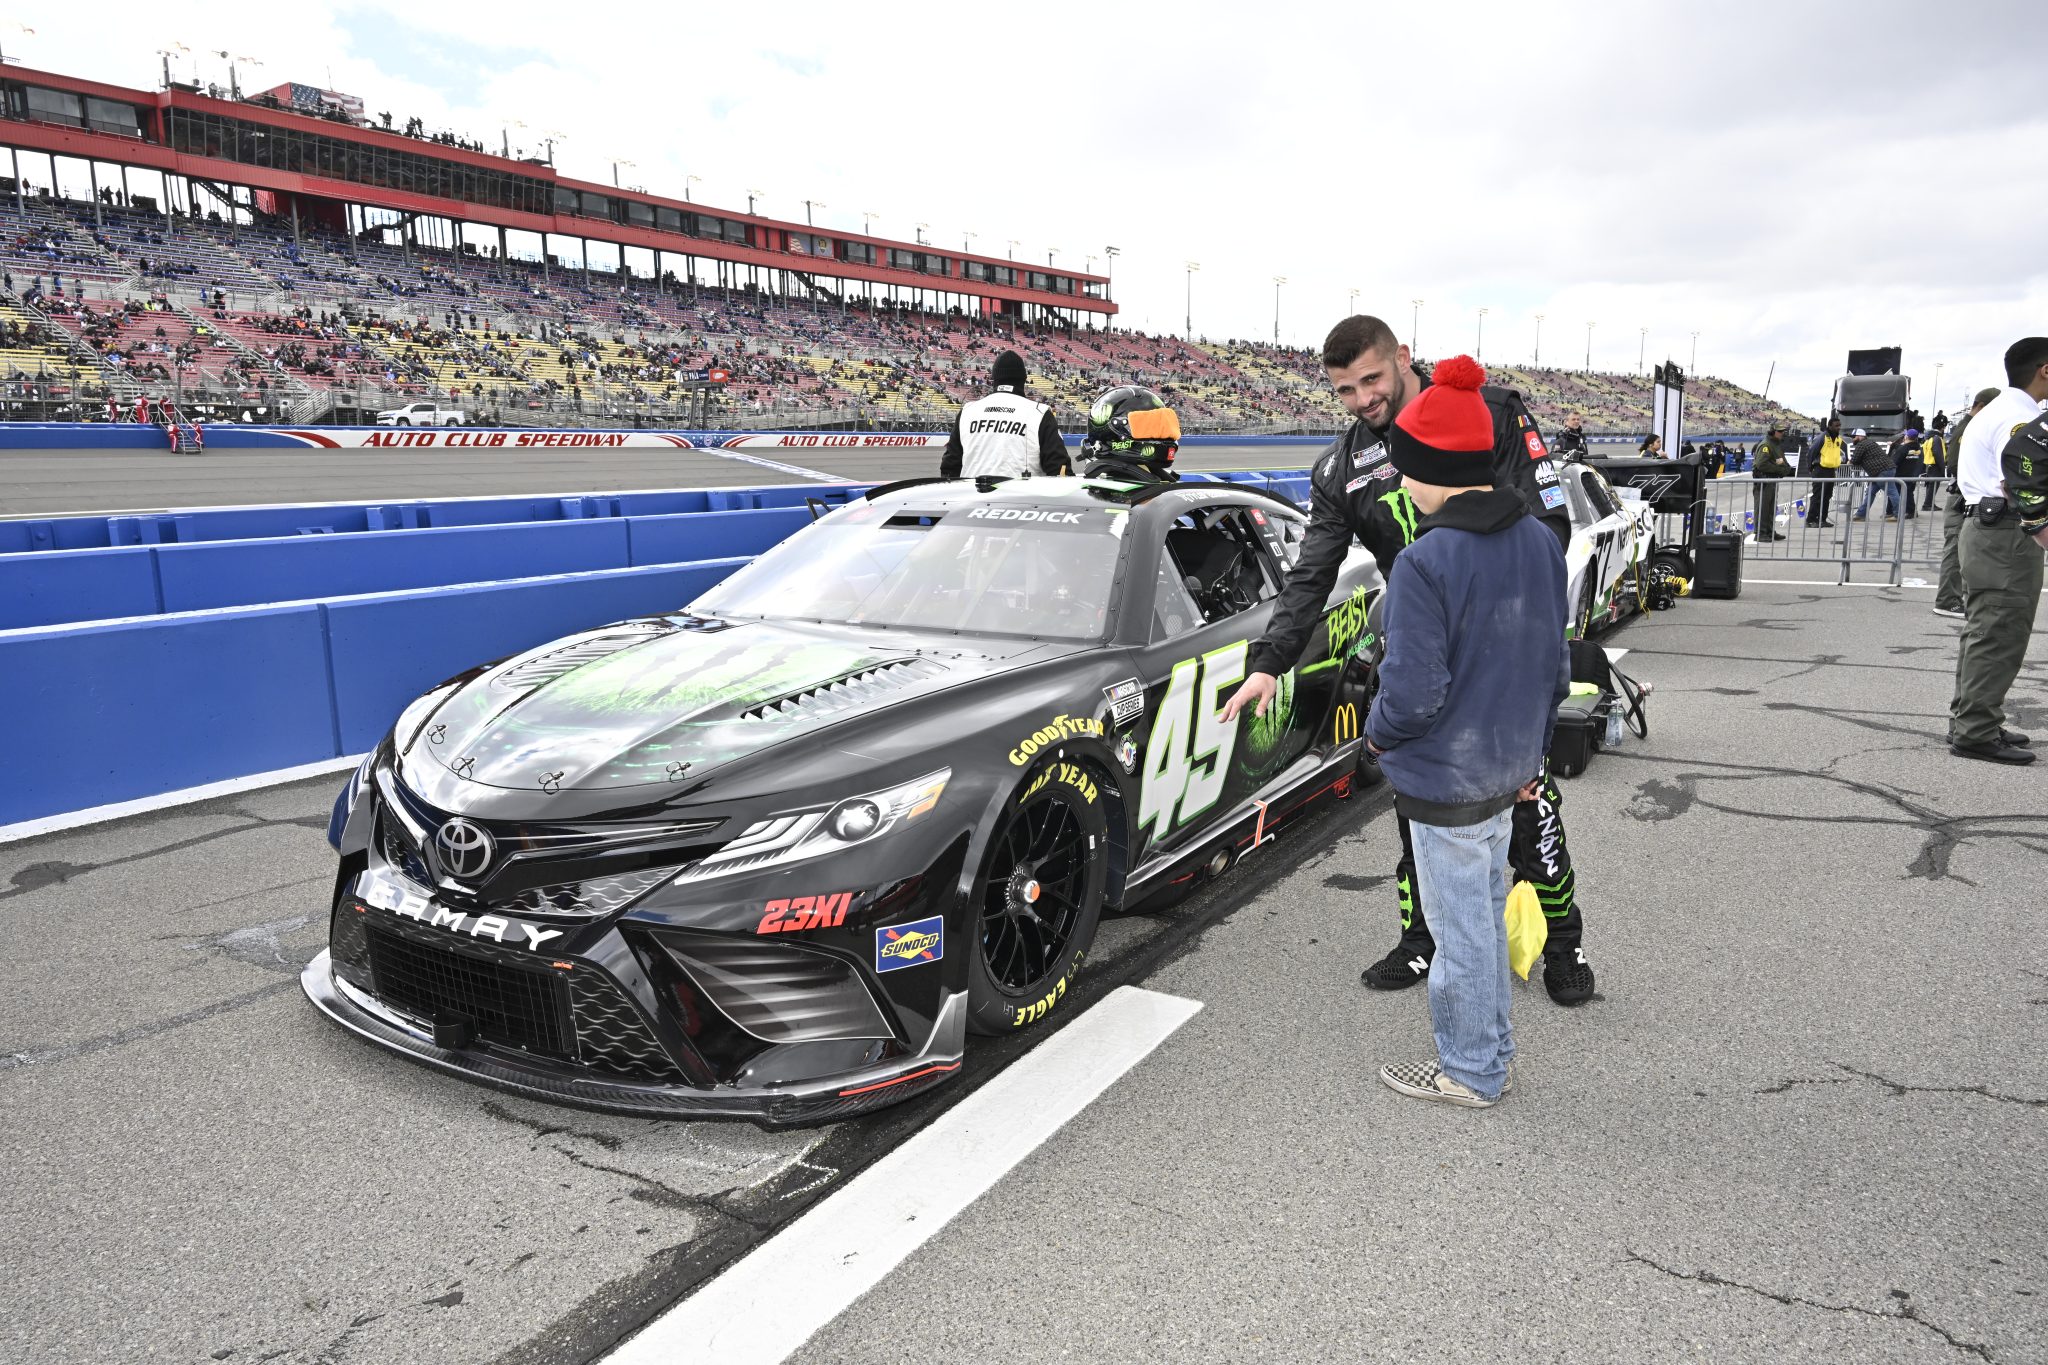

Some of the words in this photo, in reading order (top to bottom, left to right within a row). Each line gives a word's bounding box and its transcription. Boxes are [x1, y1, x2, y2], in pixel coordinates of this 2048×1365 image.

[361, 432, 436, 447] AUTO
[444, 433, 508, 447] CLUB
[515, 433, 630, 447] SPEEDWAY
[777, 436, 819, 446] AUTO
[823, 436, 859, 446] CLUB
[863, 436, 930, 446] SPEEDWAY
[970, 420, 1026, 436] OFFICIAL
[1112, 440, 1134, 450] BEAST
[1628, 474, 1681, 503] 77
[967, 509, 1084, 524] REDDICK
[1596, 529, 1615, 598] 77
[1325, 585, 1369, 659] BEAST
[1347, 633, 1375, 659] UNLEASHED
[1138, 639, 1248, 845] 45
[757, 892, 852, 934] 23XI
[883, 933, 937, 957] SUNOCO
[1013, 976, 1066, 1026] EAGLE
